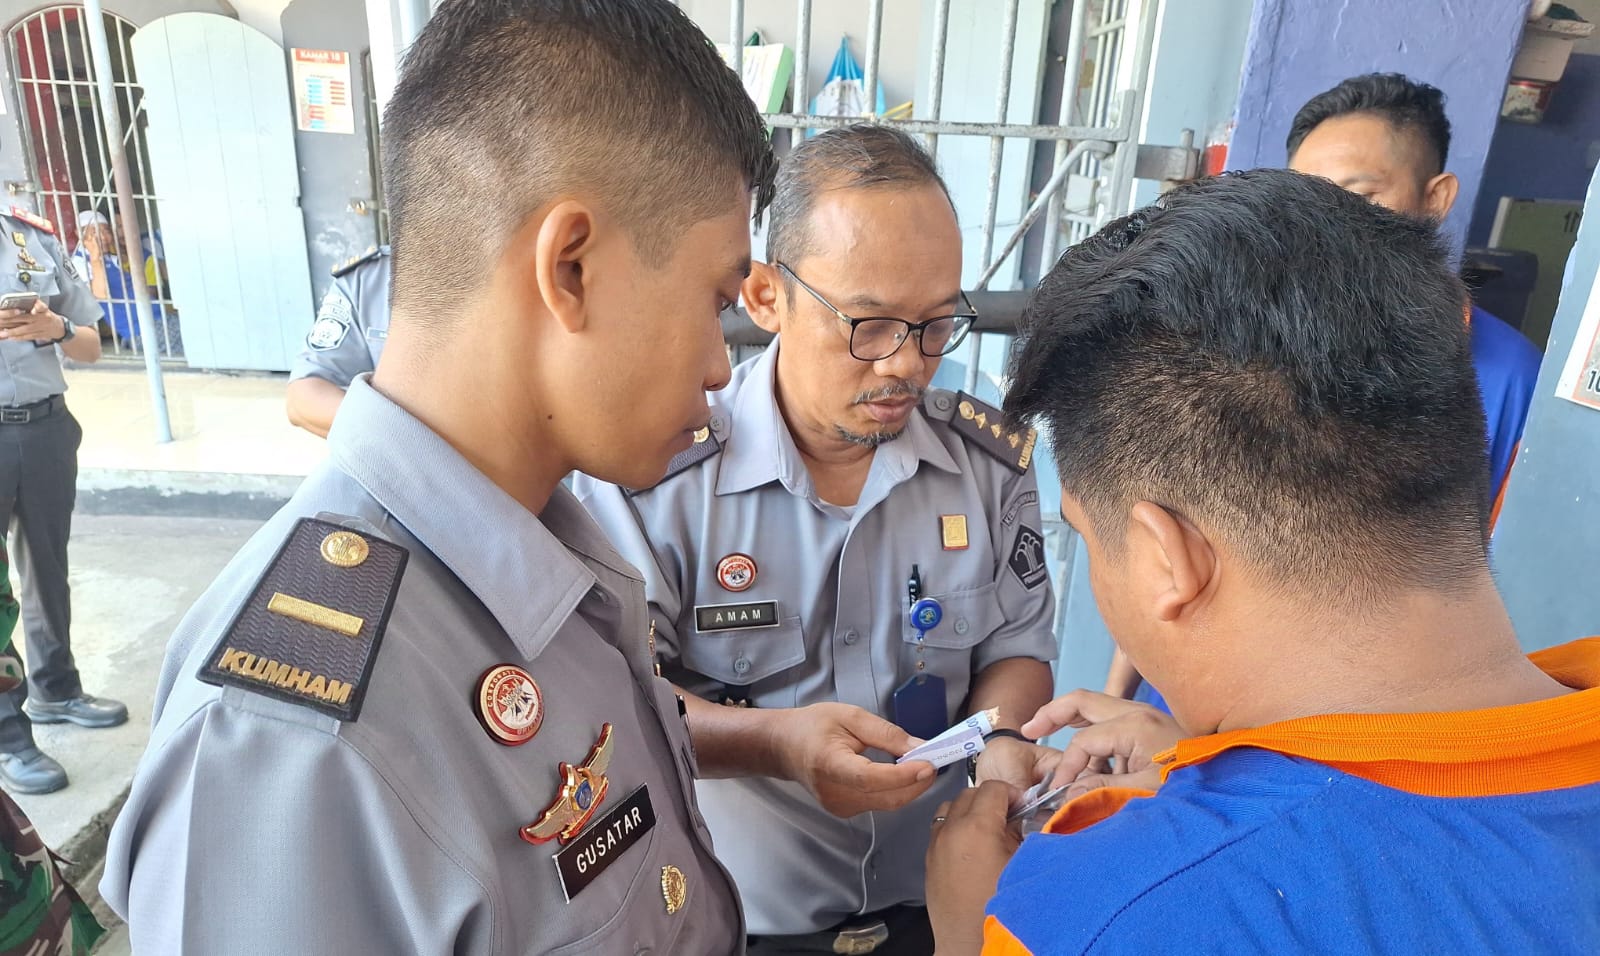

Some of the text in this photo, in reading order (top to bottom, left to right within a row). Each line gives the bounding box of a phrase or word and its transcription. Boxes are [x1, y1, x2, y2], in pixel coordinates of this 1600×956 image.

[715, 609, 761, 623] AMAM
[218, 647, 353, 704] KUMHAM
[576, 806, 642, 874] GUSATAR
